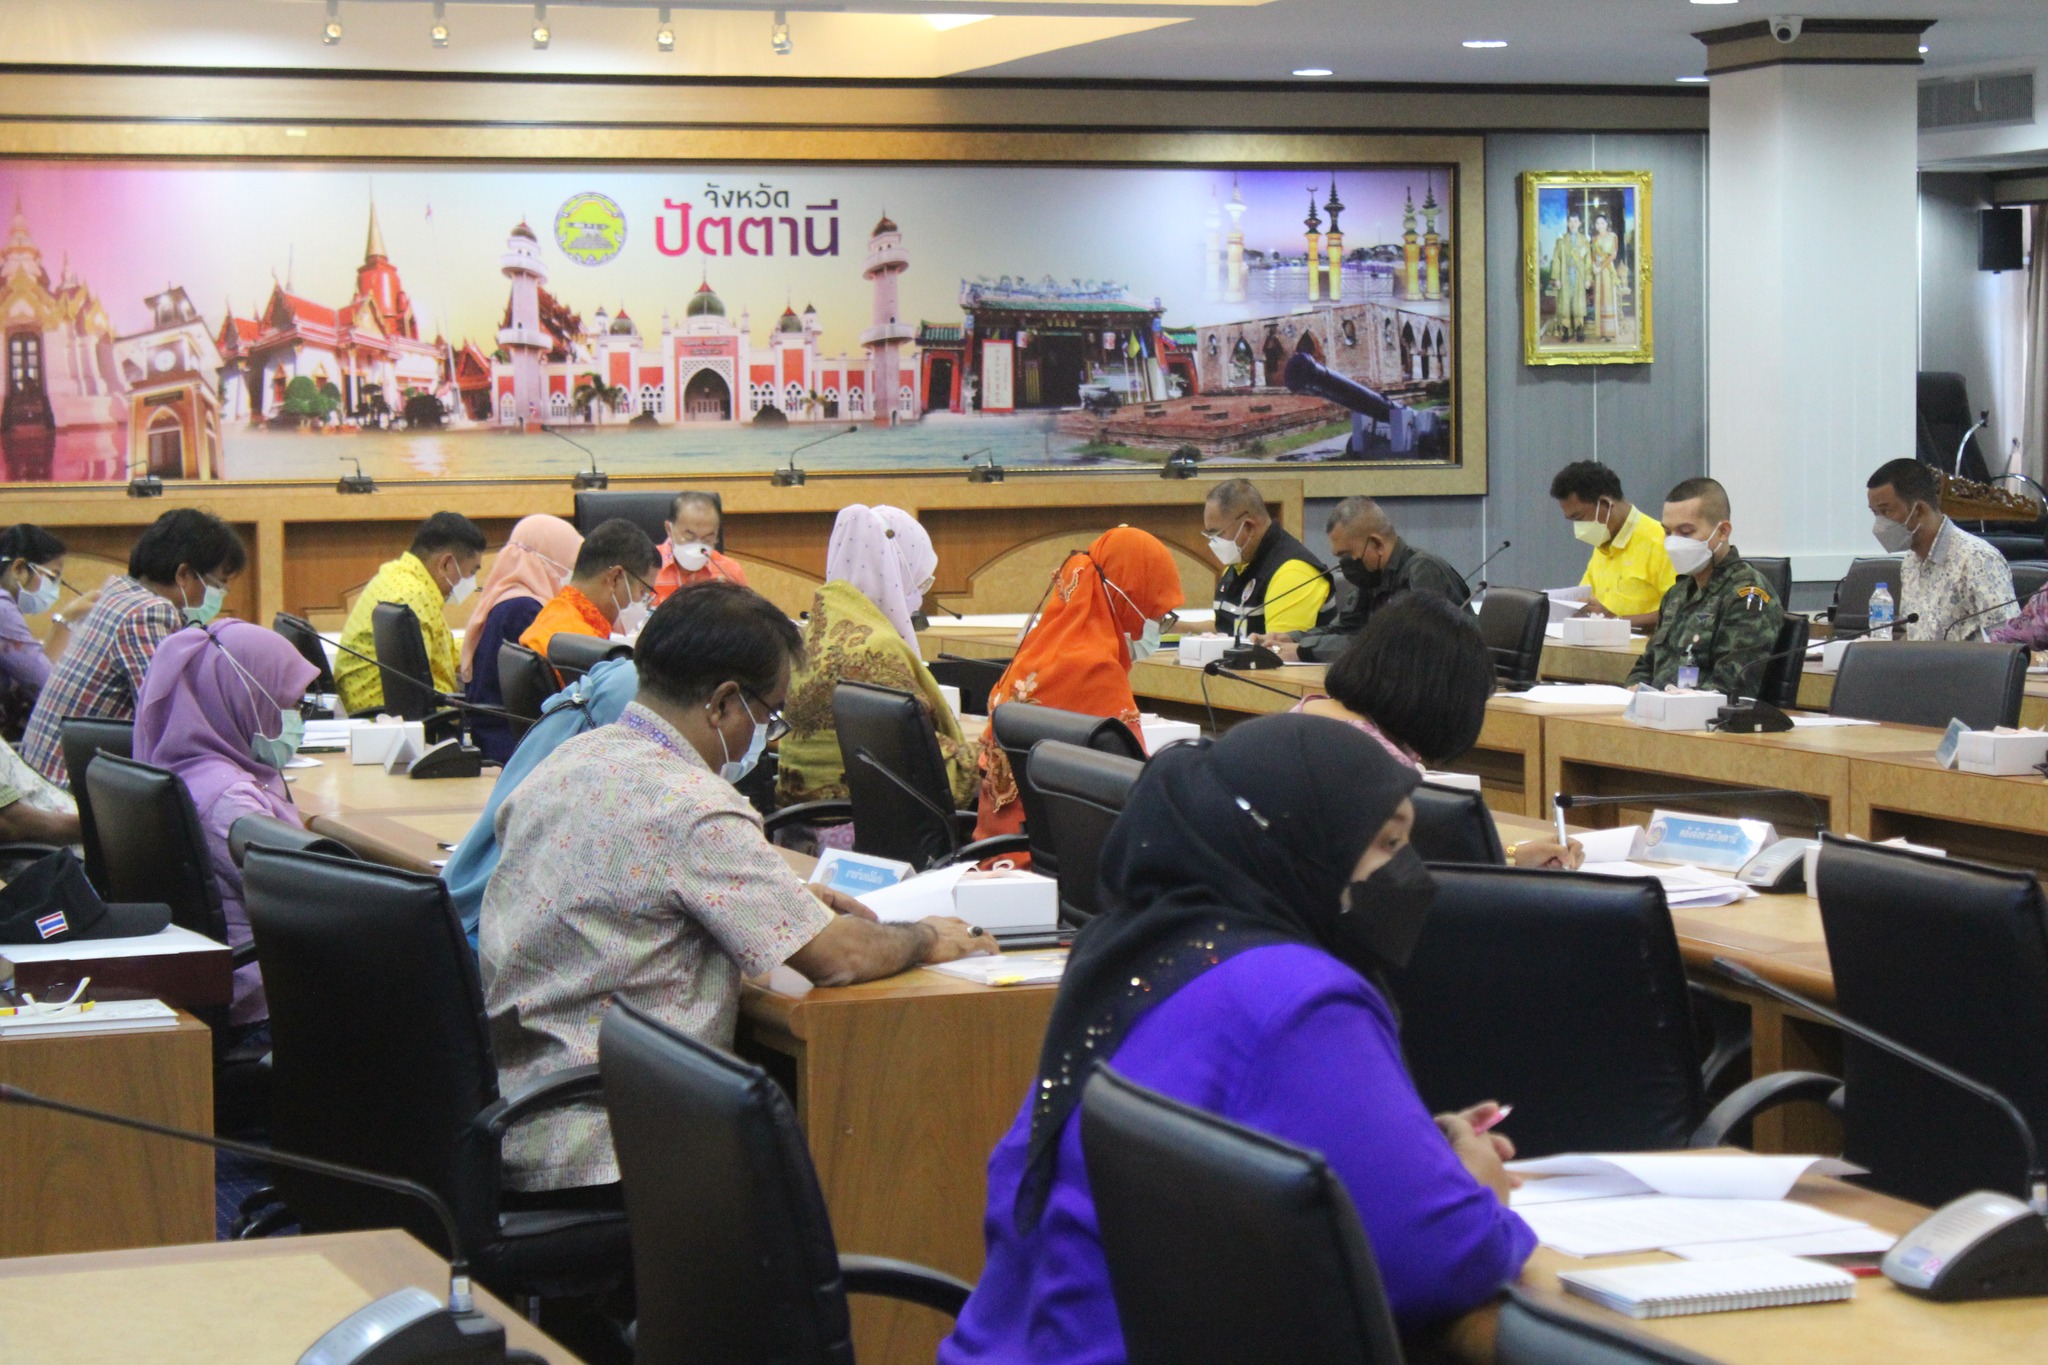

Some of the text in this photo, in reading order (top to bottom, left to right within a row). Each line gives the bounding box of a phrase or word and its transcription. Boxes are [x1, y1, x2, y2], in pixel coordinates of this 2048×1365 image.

[704, 183, 789, 208] จังหวัด
[655, 198, 838, 256] ปัตตานี
